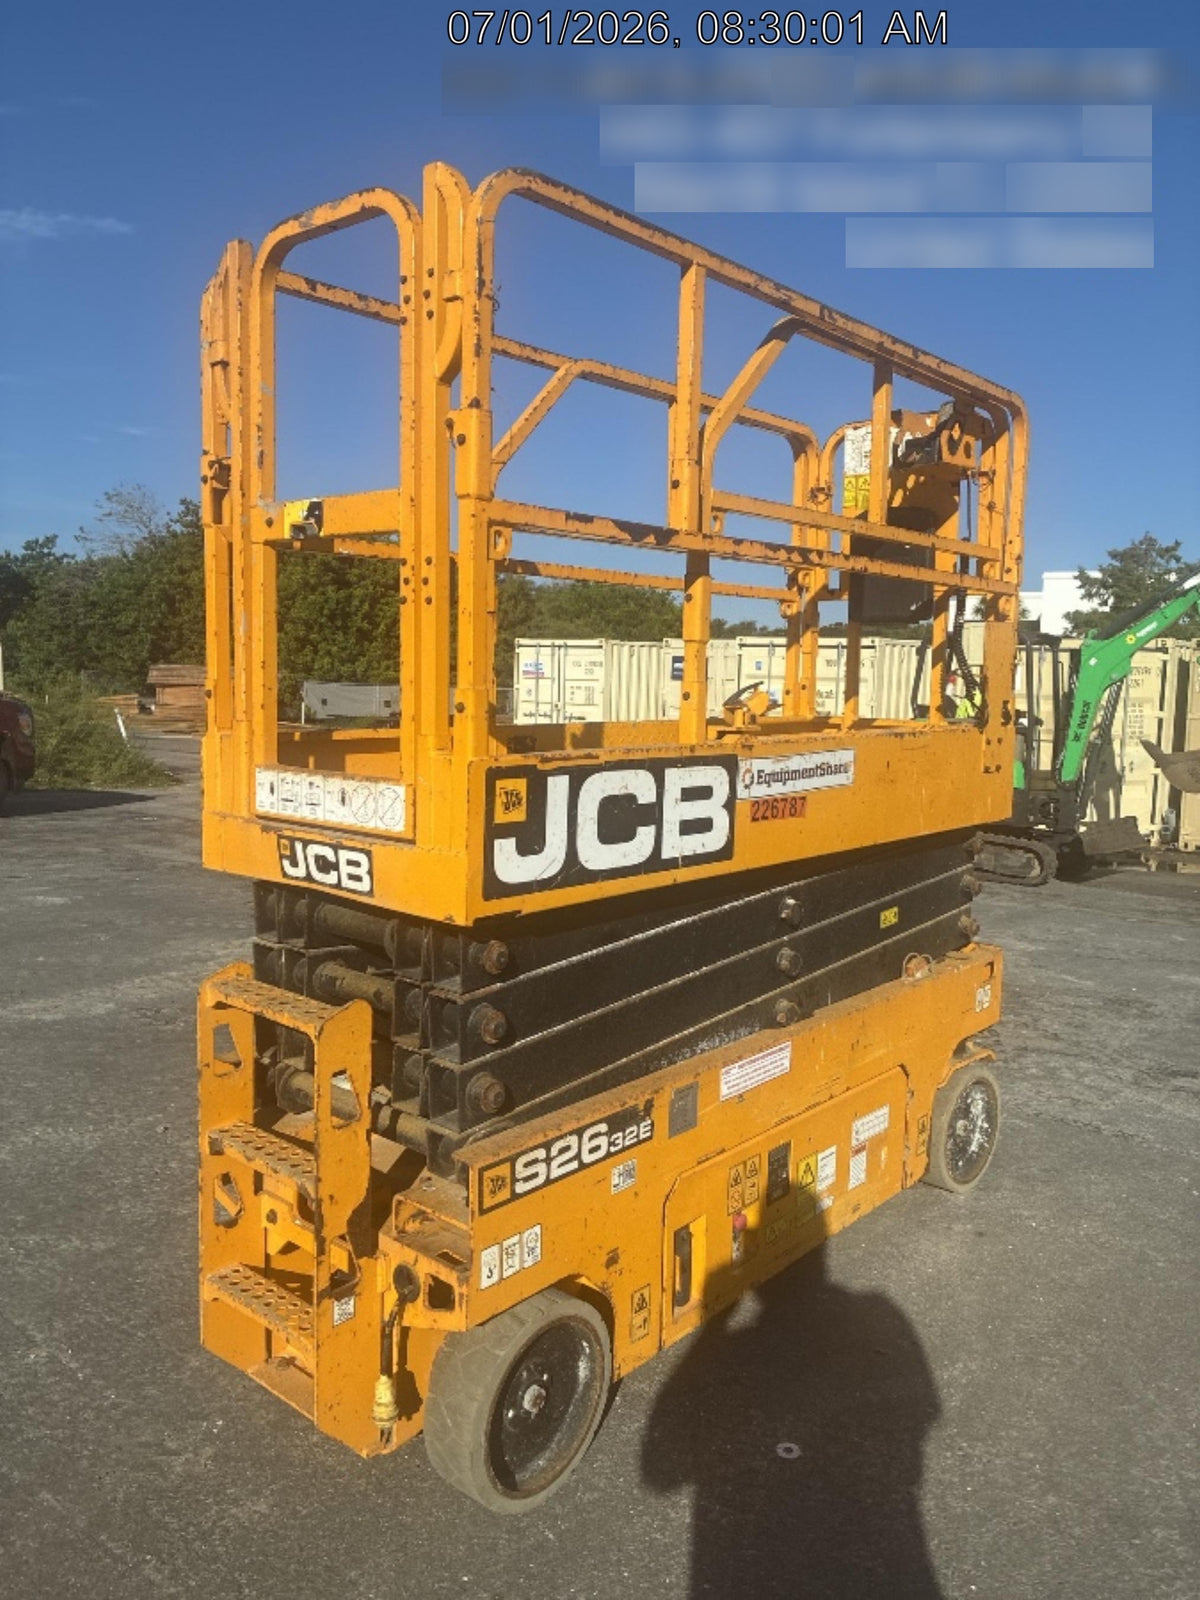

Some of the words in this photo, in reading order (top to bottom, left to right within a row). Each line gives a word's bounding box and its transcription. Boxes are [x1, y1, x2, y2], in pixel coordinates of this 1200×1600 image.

[756, 762, 851, 788] EquipmentShare
[494, 765, 730, 884] JCB
[751, 796, 806, 822] 226787
[282, 840, 371, 893] JCB
